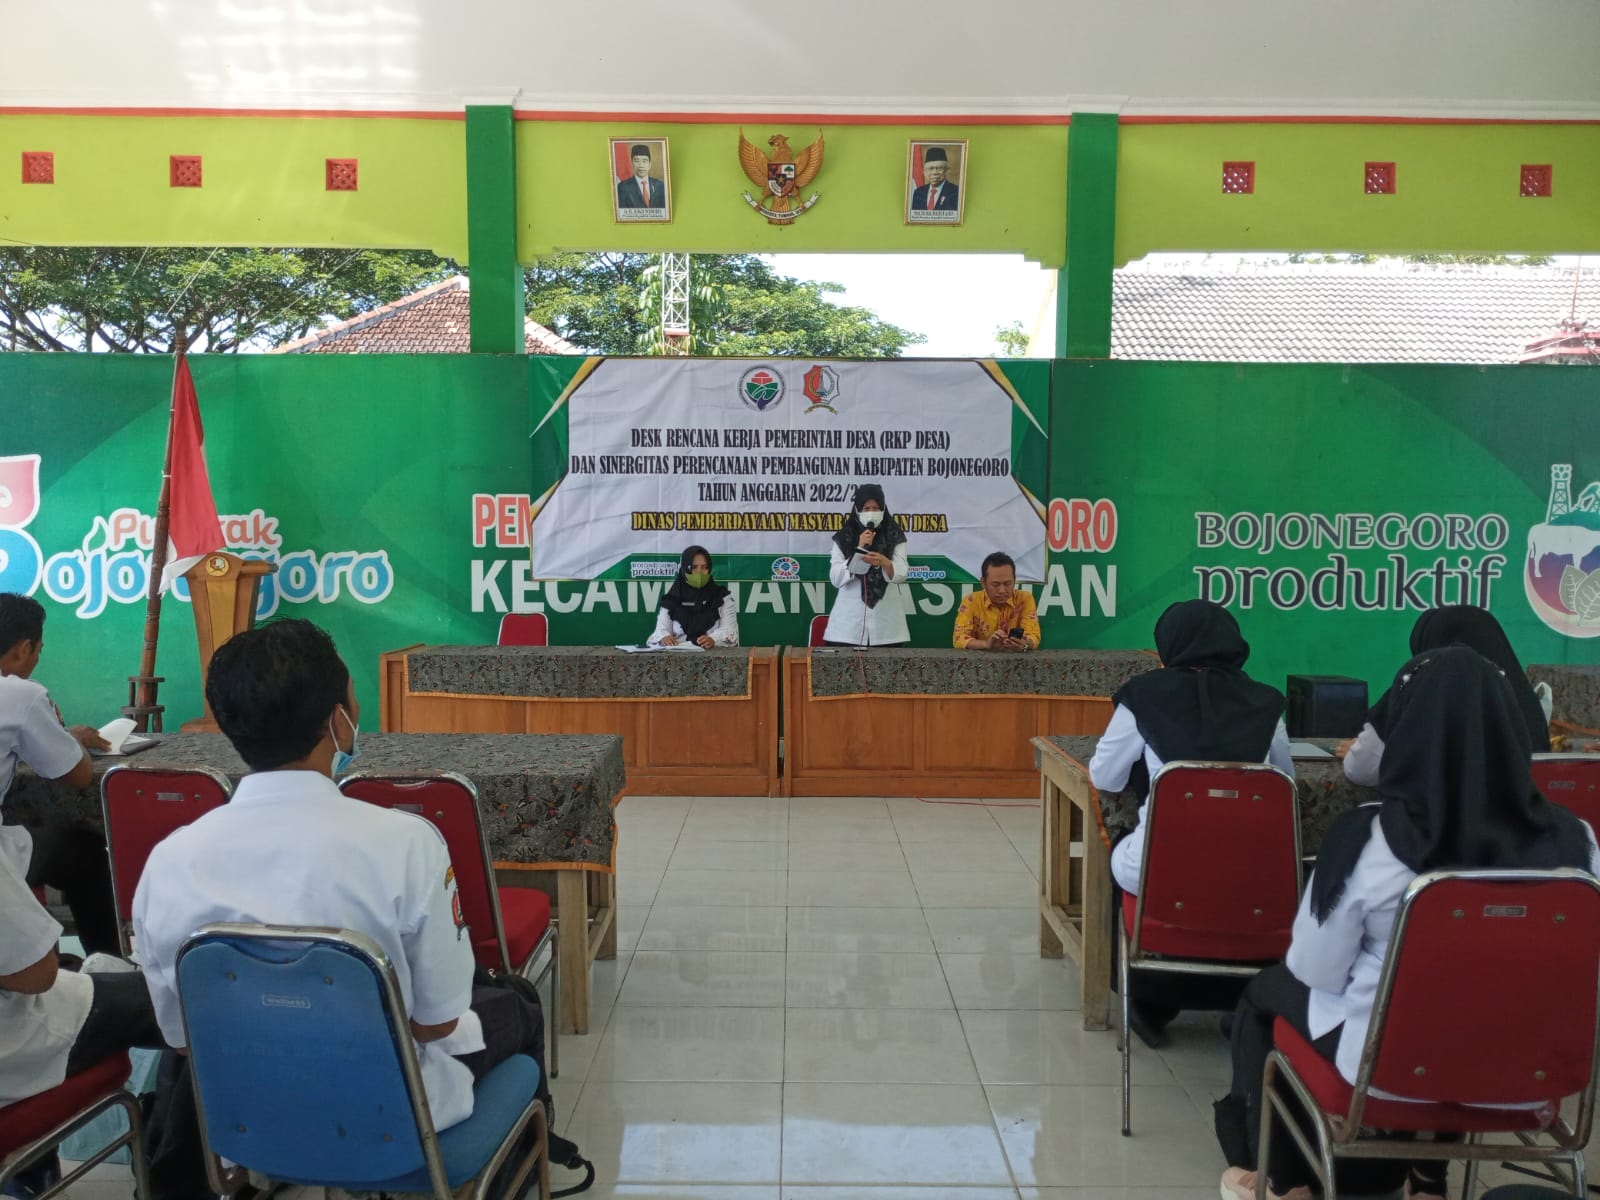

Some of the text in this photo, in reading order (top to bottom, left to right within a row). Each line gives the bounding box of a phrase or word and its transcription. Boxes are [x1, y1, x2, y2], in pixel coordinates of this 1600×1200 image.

[631, 428, 950, 451] DESK RENCANA KERJA PEMERINTAH DESA (RKP DESA)
[571, 455, 1009, 478] DAN SINERGITAS PERENCANAAN PEMBANGUNAN KABUPATEN BOJONEGORO
[698, 482, 737, 501] TAHUN
[740, 483, 806, 502] ANGGARAN
[631, 511, 674, 531] DINAS
[675, 511, 787, 532] PEMBERDAYAAN
[911, 514, 949, 533] DESA
[1195, 511, 1509, 554] BOJONEGORO
[632, 567, 676, 578] produktif
[1193, 553, 1507, 611] produktif
